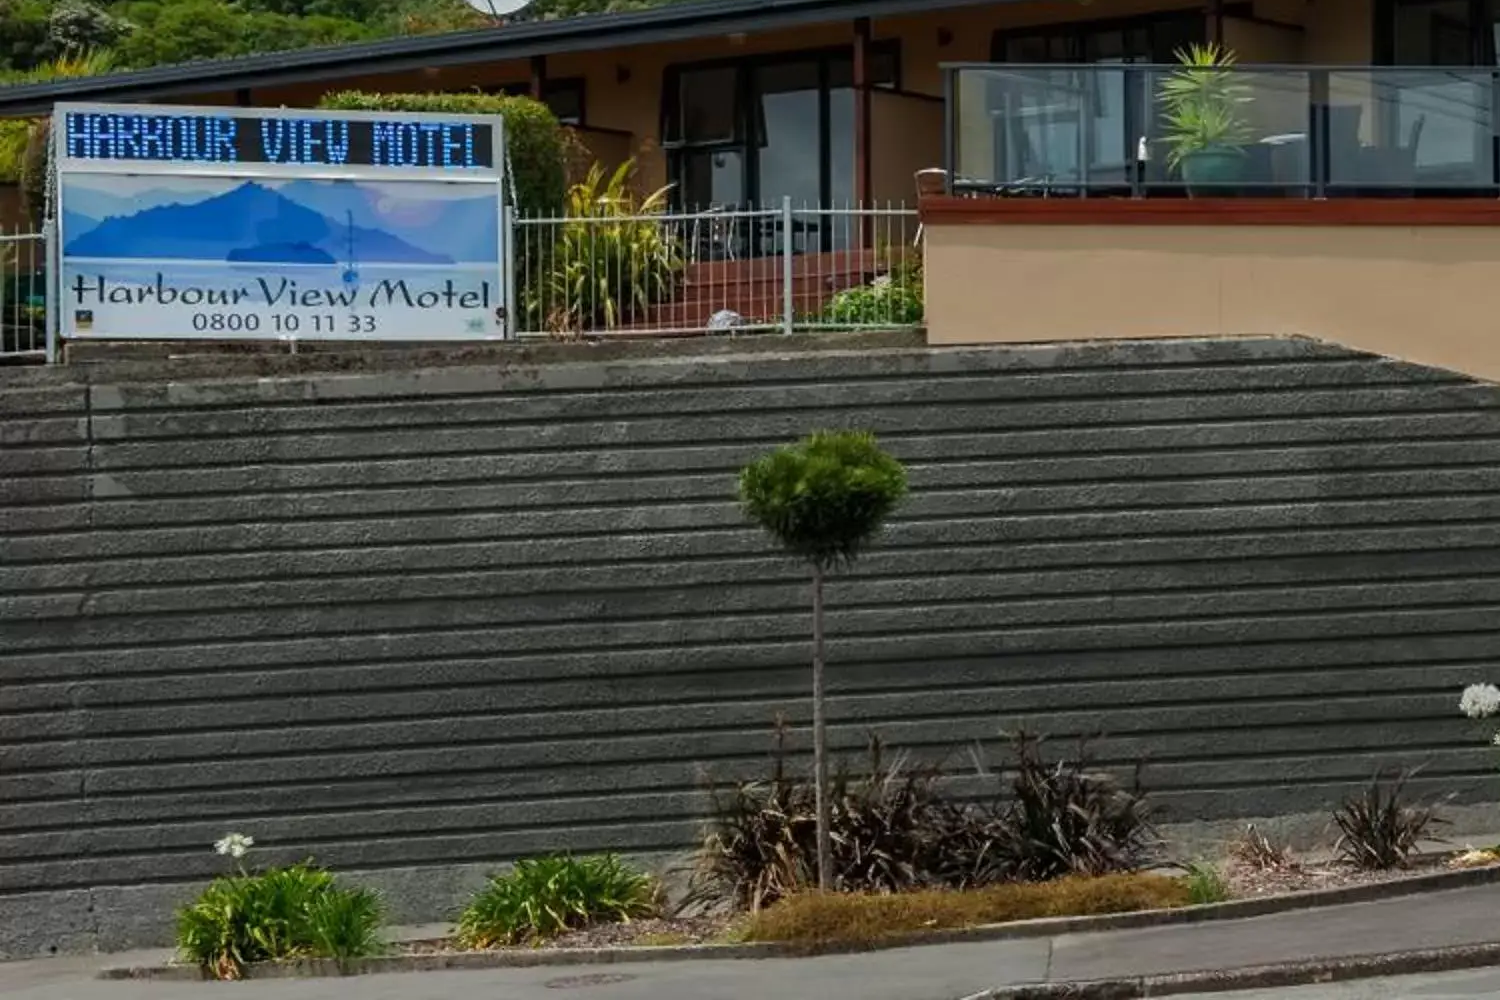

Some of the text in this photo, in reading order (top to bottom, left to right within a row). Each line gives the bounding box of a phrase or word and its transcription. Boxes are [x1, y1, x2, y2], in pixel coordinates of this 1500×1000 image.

[261, 118, 349, 164] VIEW
[373, 121, 482, 168] MOTEL
[72, 271, 489, 309] Harbour View Motel
[192, 313, 376, 332] 0800 10 11 33
